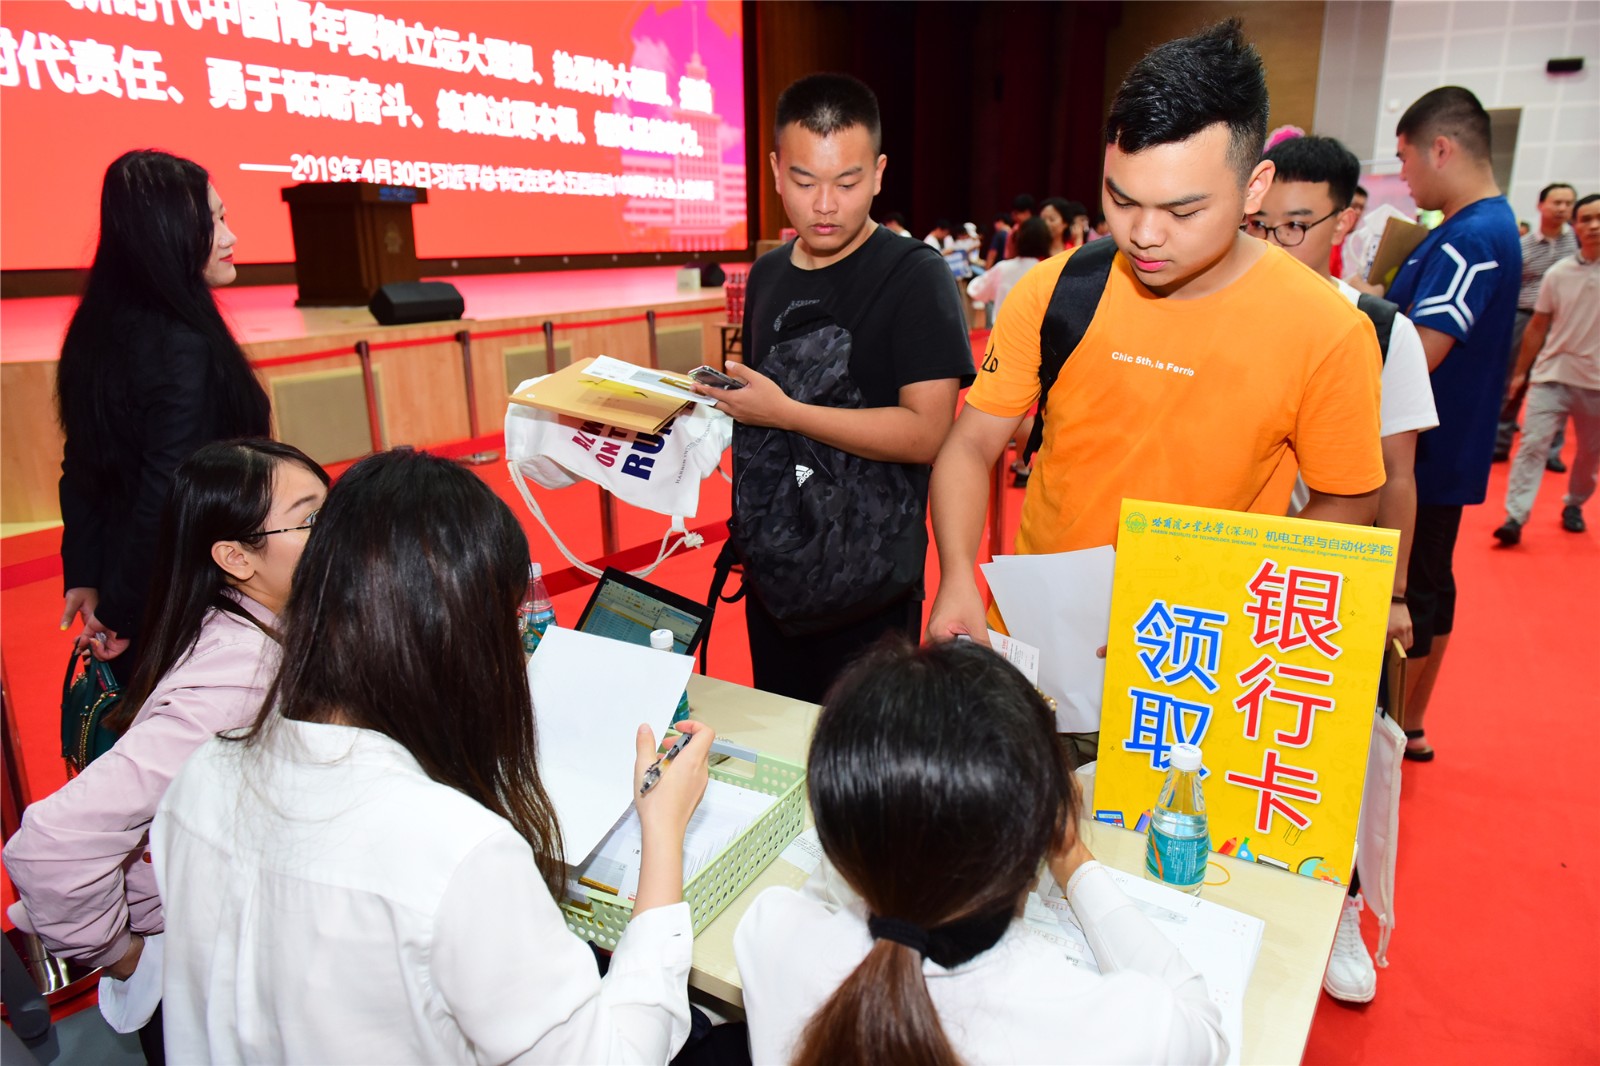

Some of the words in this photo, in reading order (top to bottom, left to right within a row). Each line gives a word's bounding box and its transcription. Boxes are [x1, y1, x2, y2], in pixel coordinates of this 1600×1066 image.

[595, 441, 621, 468] ON
[1265, 530, 1394, 557] 机电工程与自动化学院
[1124, 602, 1227, 777] 领取
[1226, 560, 1342, 831] 银行卡
